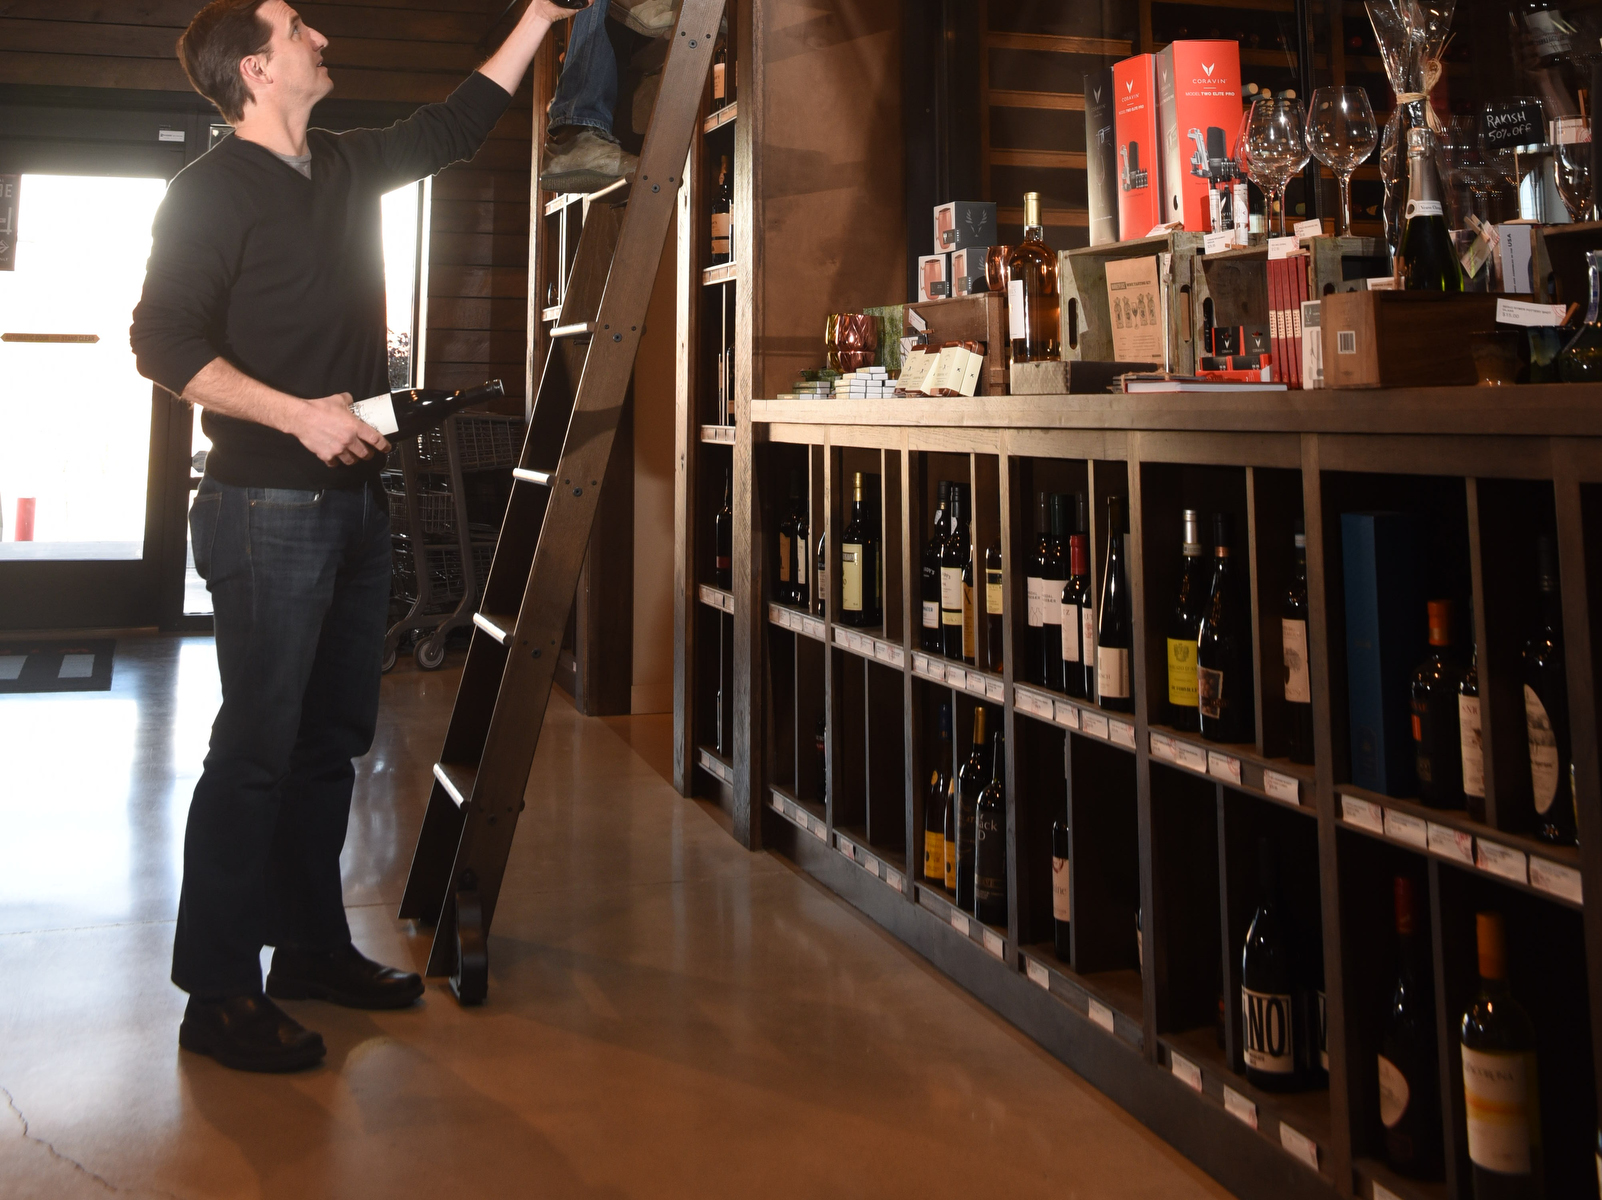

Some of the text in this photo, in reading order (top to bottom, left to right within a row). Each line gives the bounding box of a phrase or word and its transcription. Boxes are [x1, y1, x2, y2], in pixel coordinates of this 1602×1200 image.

[1486, 110, 1527, 128] RAKISH
[1488, 123, 1532, 142] 50% OFF
